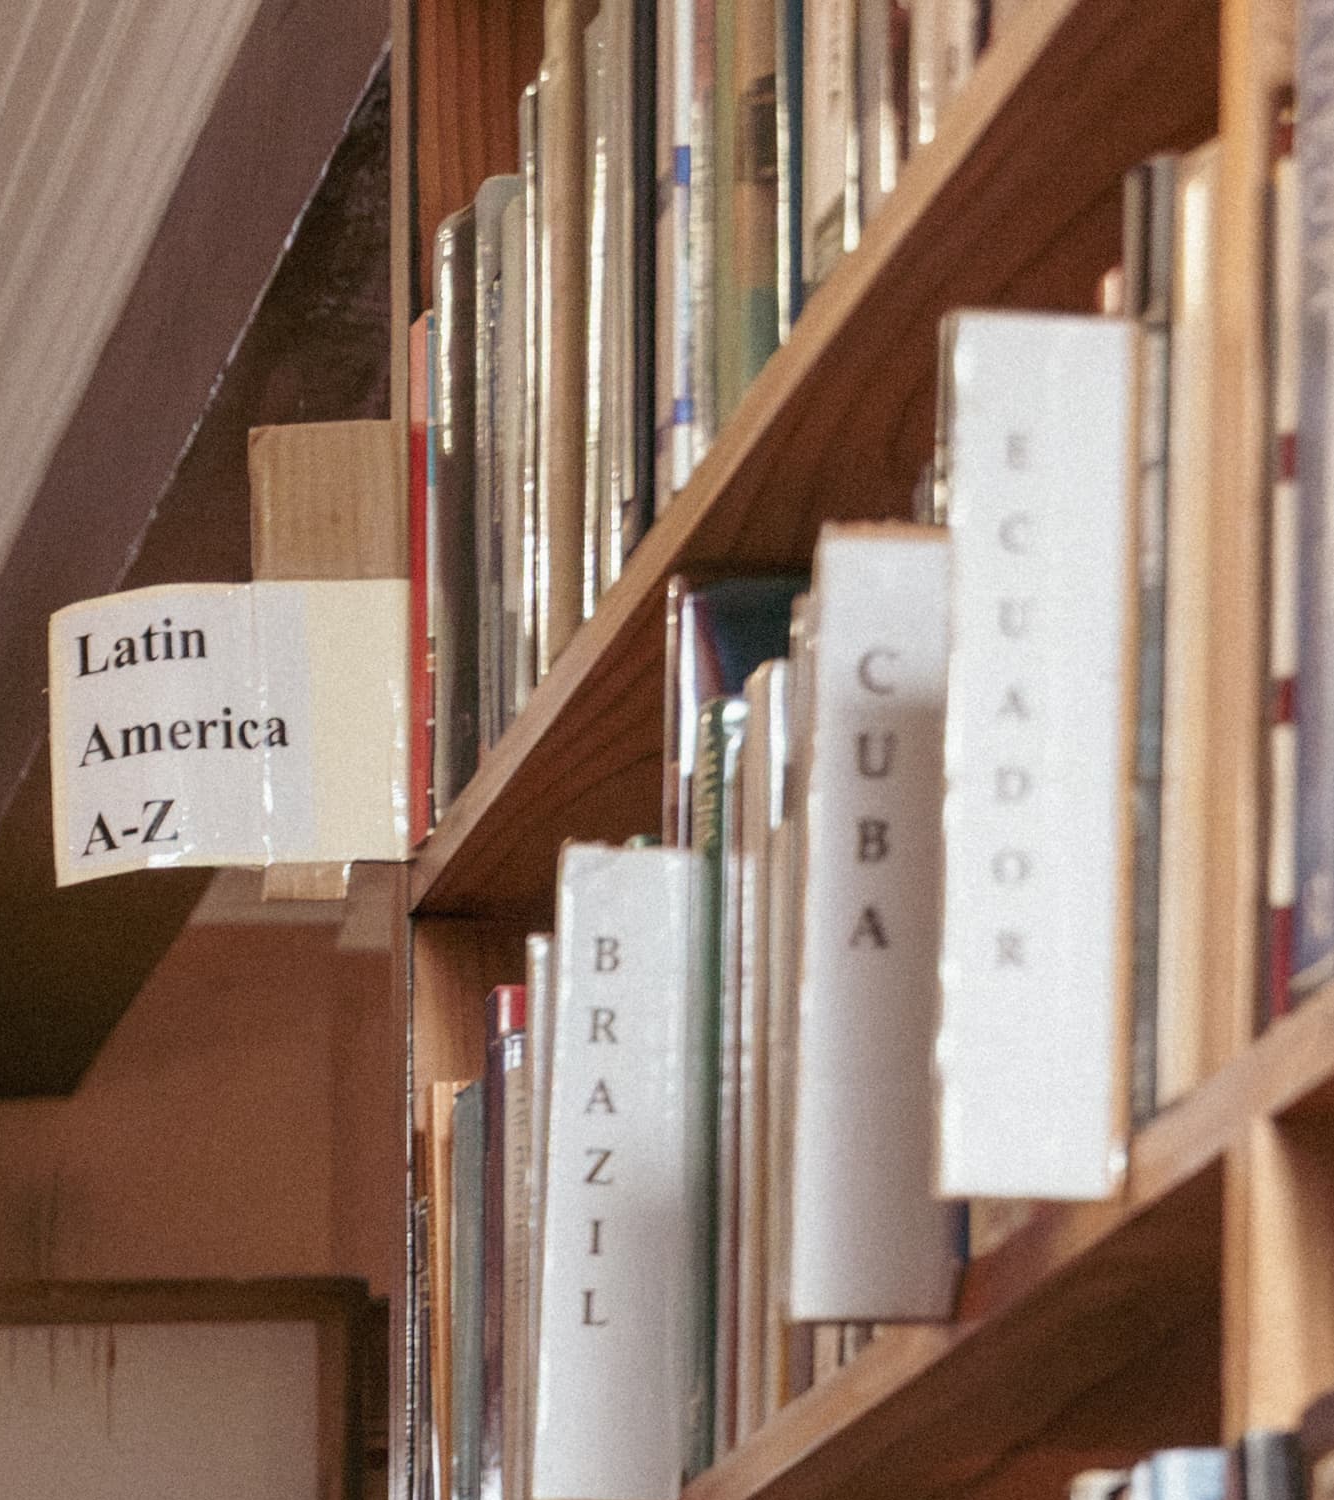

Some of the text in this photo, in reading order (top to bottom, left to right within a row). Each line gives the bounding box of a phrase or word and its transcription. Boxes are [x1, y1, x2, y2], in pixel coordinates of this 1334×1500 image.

[76, 616, 208, 681] Latin
[77, 707, 291, 768] America
[991, 431, 1032, 969] ECUADOR
[80, 800, 180, 857] A-Z
[850, 647, 898, 953] CUBA
[581, 936, 621, 1328] BRAZIL
